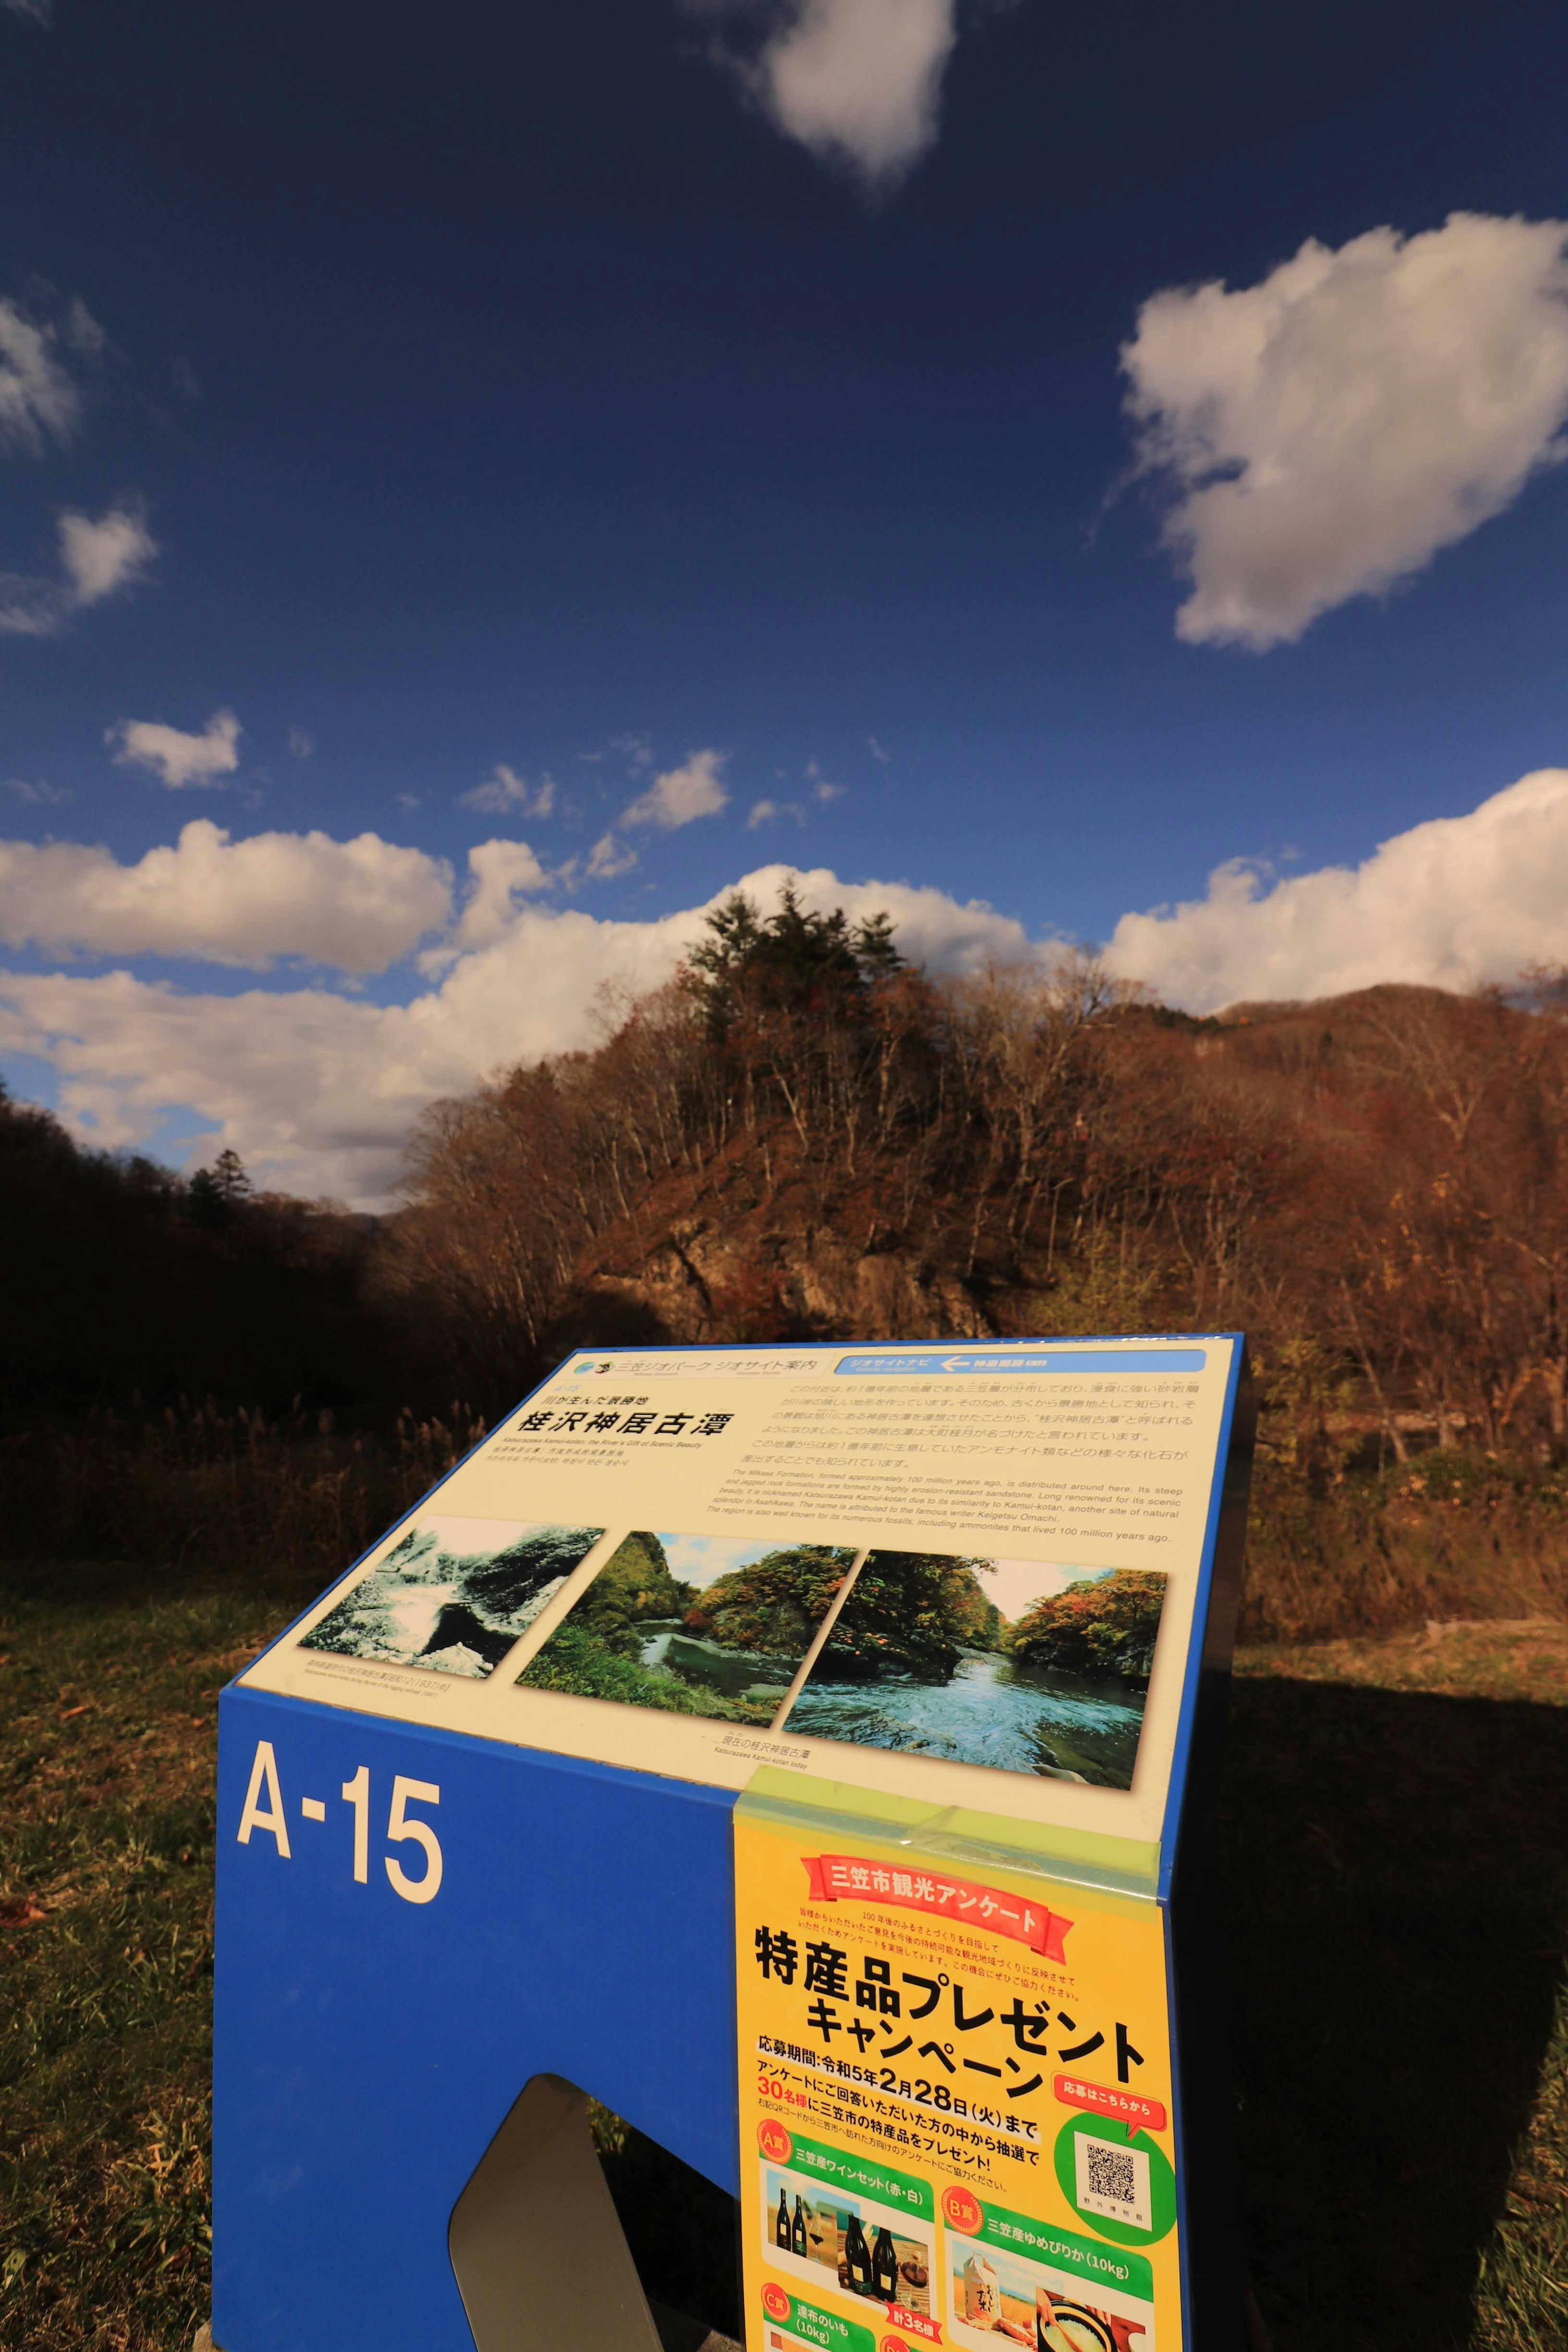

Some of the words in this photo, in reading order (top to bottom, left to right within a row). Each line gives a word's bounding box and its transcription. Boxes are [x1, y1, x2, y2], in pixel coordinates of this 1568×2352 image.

[615, 1361, 711, 1371] 三笠ジオパーク
[714, 1360, 817, 1370] ジオサイト案内
[851, 1358, 931, 1367] ジオサイトナビ
[542, 1395, 649, 1405] 川が生んだ景勝地
[517, 1411, 736, 1436] 桂沢神居古潭
[777, 1470, 815, 1479] Formation,
[848, 1474, 903, 1483] approximately
[1019, 1480, 1067, 1489] distributed
[1071, 1483, 1105, 1491] around
[1108, 1484, 1133, 1492] here.
[1155, 1487, 1183, 1496] steep
[884, 1485, 909, 1493] highly
[912, 1487, 984, 1496] erosion-resistant
[985, 1490, 1034, 1499] sandstone.
[1038, 1492, 1062, 1502] Long
[1065, 1494, 1112, 1503] renowned
[1132, 1496, 1144, 1504] its
[1148, 1498, 1181, 1506] scenic
[754, 1499, 796, 1507] Asahikawa.
[848, 1504, 887, 1513] attributed
[916, 1507, 947, 1516] famous
[950, 1509, 974, 1517] writer
[977, 1511, 1017, 1520] Keigetsu
[1020, 1513, 1059, 1523] Omachi.
[762, 1489, 802, 1497] nicknamed
[803, 1491, 853, 1500] Katsurazawa
[855, 1494, 907, 1503] Kamui-kotan
[950, 1499, 990, 1508] similarity
[1004, 1502, 1065, 1512] Kamui-kotan,
[1069, 1505, 1106, 1514] another
[1109, 1507, 1127, 1515] site
[1143, 1510, 1179, 1518] natural
[842, 1515, 883, 1523] numerous
[885, 1516, 913, 1526] fossils,
[917, 1518, 957, 1528] including
[959, 1522, 1009, 1531] ammonites
[1012, 1524, 1031, 1533] that
[1033, 1526, 1056, 1534] lived
[1060, 1528, 1078, 1536] 100
[1081, 1528, 1113, 1538] million
[1116, 1531, 1145, 1540] years
[1148, 1534, 1171, 1543] ago.
[714, 1746, 751, 1759] Katsurazawa
[752, 1754, 789, 1765] Kamui-kotan
[790, 1760, 808, 1770] today
[721, 1735, 812, 1759] 現在の桂沢神居古潭
[236, 1739, 443, 1904] A-15
[831, 1865, 1036, 1933] 三笠市観光アンケート
[800, 1907, 1076, 1986] 皆様からいただいたご意見を今後の持続可能な観光地域づくりに反映させて
[798, 1920, 1079, 2002] いただくためアンケートを実施しています。この機会にぜひご協力ください。
[754, 1925, 1145, 2084] 特産品プレゼント
[807, 1998, 1044, 2099] キャンペーン
[1063, 2081, 1151, 2116] 応募はこちらから
[757, 2060, 1040, 2166] アンケートにご回答いただいた方の中から抽選で
[758, 2097, 1007, 2193] 右記QRコードから三笠市へ訪れた方向けのアンケートにご協力ください。
[764, 2131, 784, 2152] A賞
[949, 2199, 974, 2222] B賞
[766, 2293, 785, 2312] C賞
[796, 2304, 849, 2338] 達布のいも
[892, 2311, 935, 2339] 計3名様
